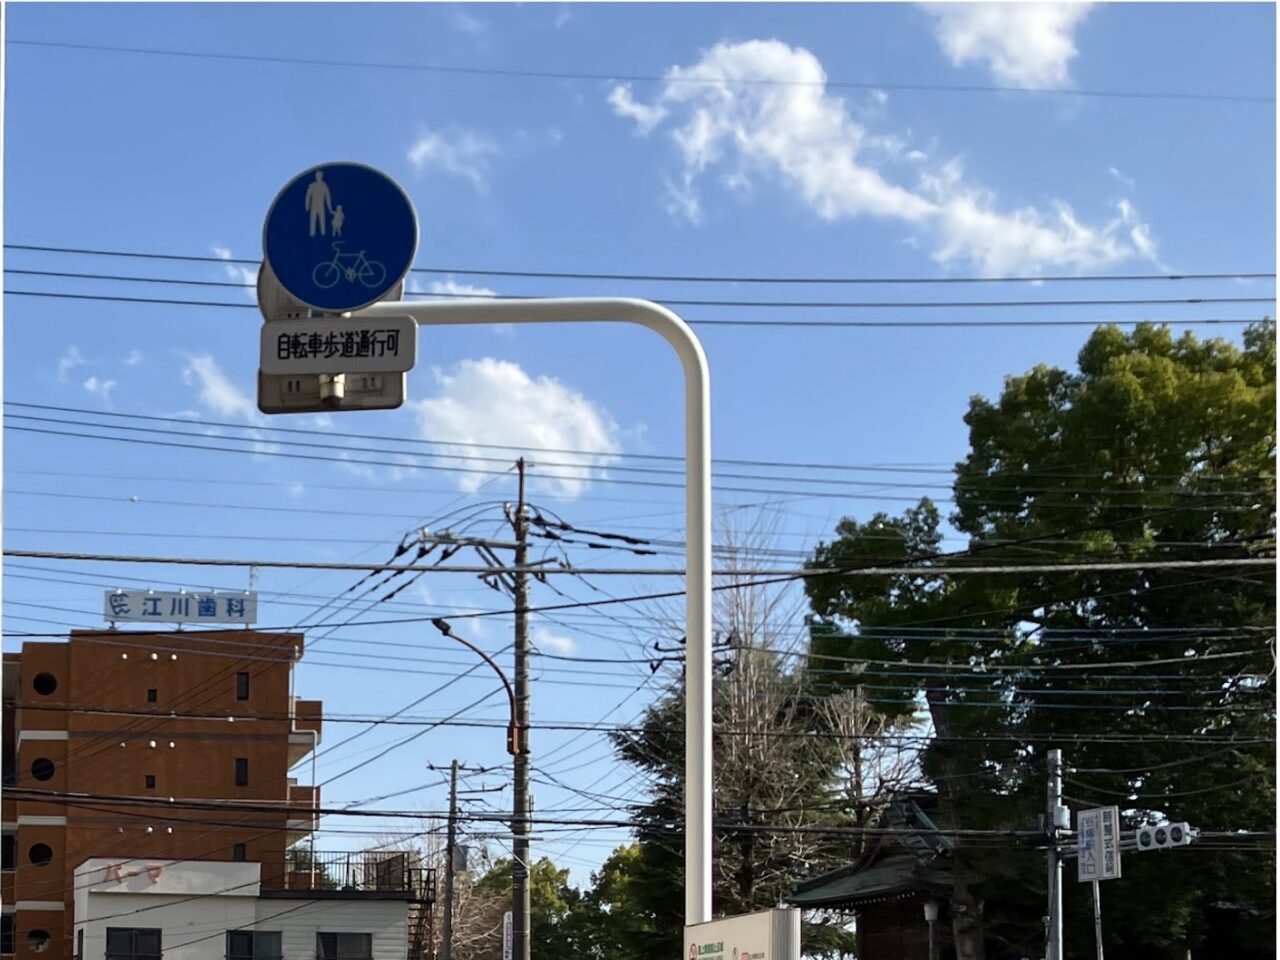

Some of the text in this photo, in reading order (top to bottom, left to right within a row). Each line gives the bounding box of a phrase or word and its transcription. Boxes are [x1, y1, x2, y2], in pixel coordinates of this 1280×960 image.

[277, 328, 401, 361] 自転車歩道通行可
[141, 597, 246, 618] 江川歯科
